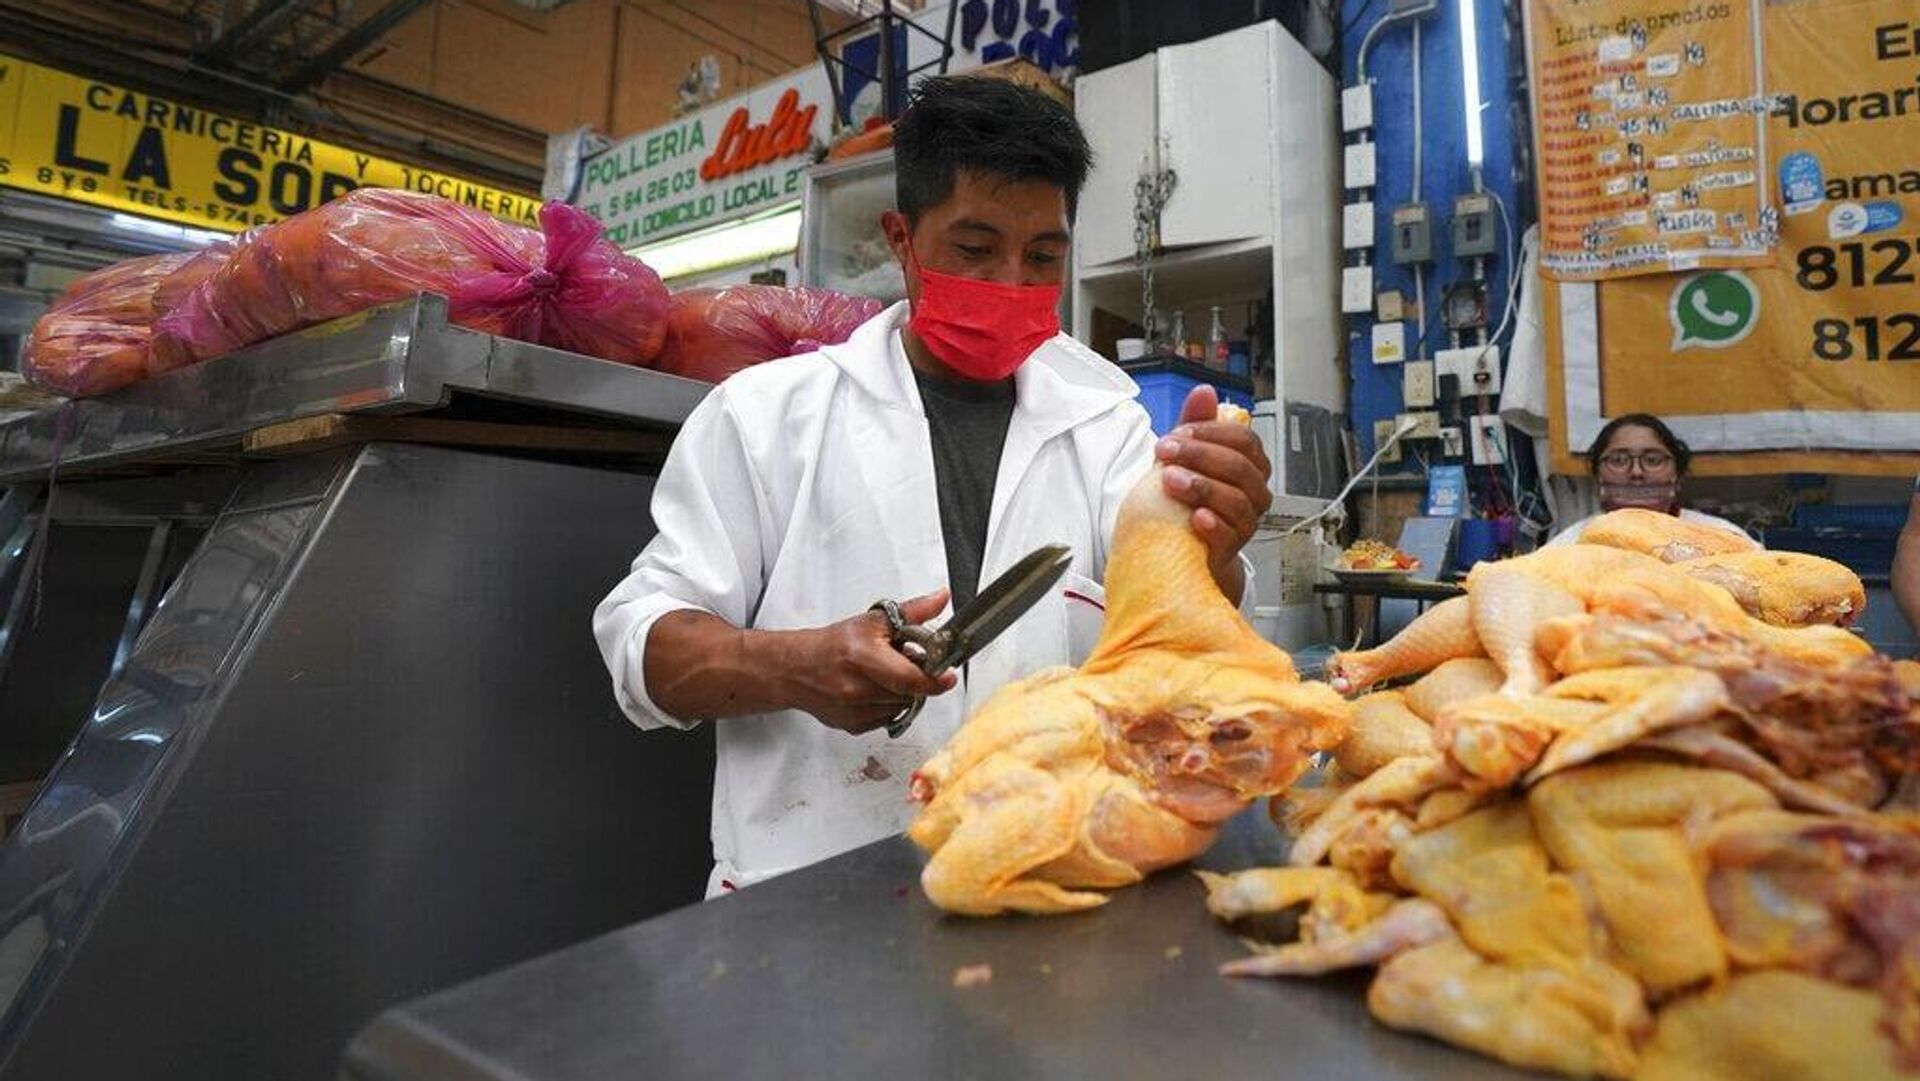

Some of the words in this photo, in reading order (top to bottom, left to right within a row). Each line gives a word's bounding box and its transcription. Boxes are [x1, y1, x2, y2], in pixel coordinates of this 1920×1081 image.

[1648, 5, 1730, 34] precios
[1875, 22, 1920, 61] E
[1770, 76, 1920, 128] orar
[55, 103, 172, 190] LA
[86, 85, 314, 165] CARNICERIA
[355, 155, 369, 178] Y
[586, 120, 705, 193] POLLERIA
[701, 87, 818, 182] Lulu
[643, 195, 715, 236] DOMICILIO
[722, 175, 779, 212] LOCAL
[672, 168, 696, 193] 03
[1826, 171, 1920, 200] ama
[1797, 238, 1920, 292] 812
[1813, 313, 1920, 361] 812
